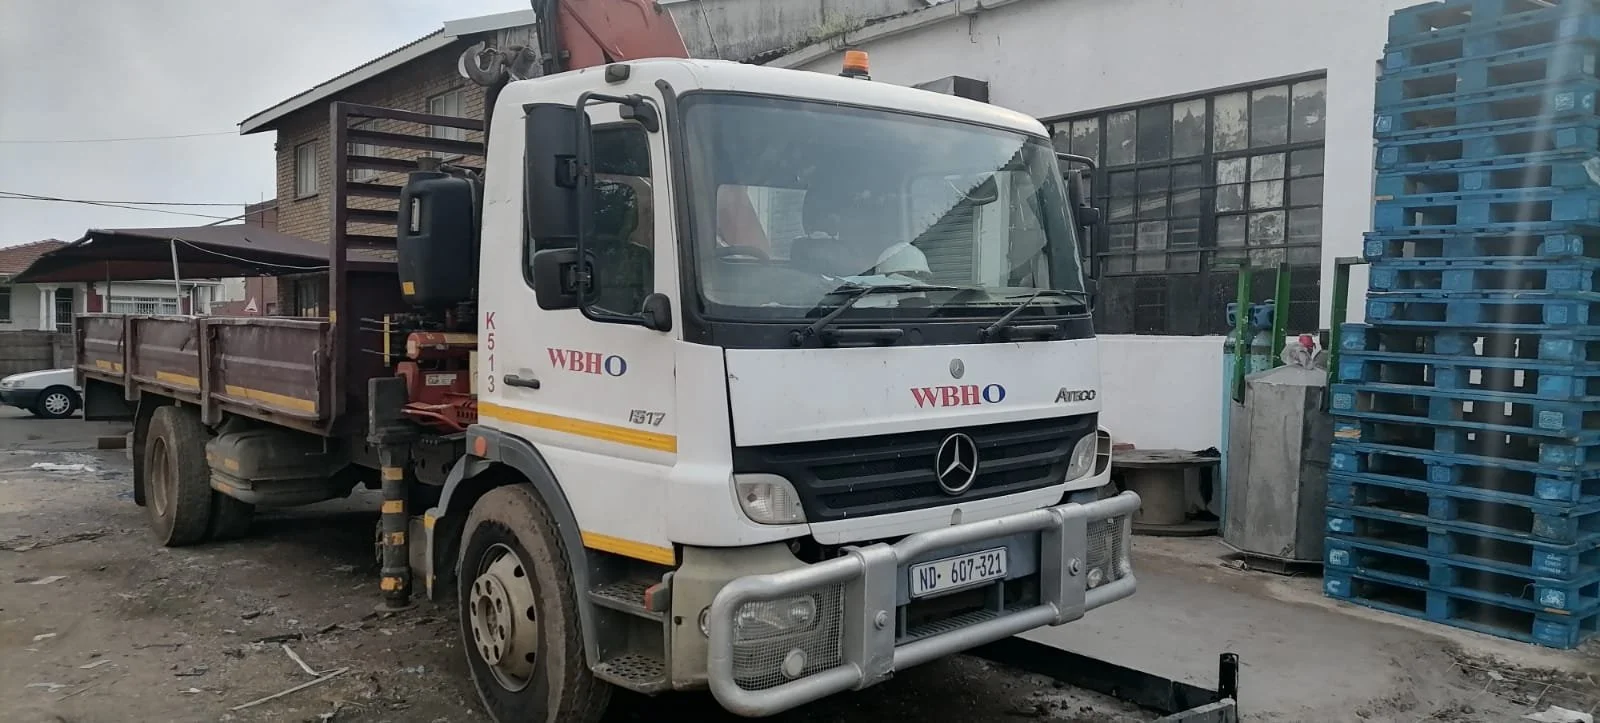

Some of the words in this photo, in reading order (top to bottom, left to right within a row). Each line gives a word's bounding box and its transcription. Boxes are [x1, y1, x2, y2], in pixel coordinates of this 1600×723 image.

[547, 348, 628, 377] WBHO
[910, 383, 1006, 409] WBHO
[951, 552, 1002, 584] 607-321
